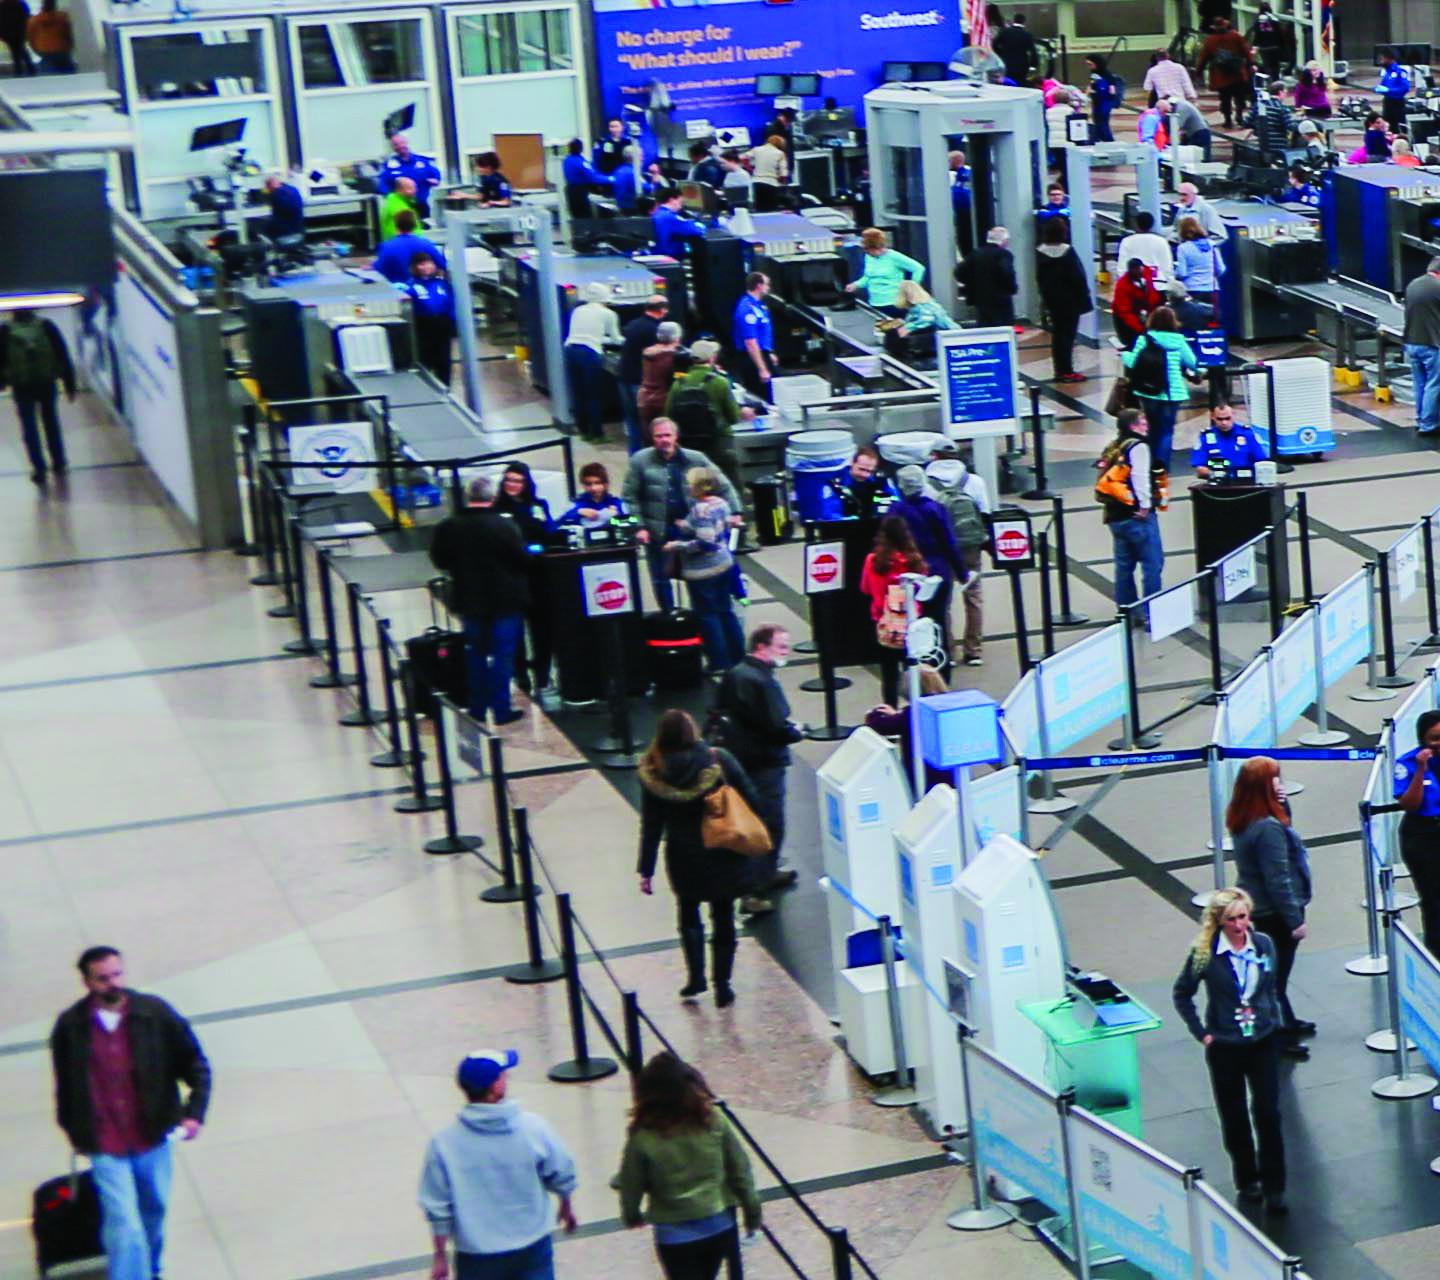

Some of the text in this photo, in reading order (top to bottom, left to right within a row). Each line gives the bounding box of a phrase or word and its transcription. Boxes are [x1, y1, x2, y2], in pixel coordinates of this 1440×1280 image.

[860, 9, 939, 31] Southwest
[616, 24, 732, 48] No charge for
[677, 46, 735, 66] should
[996, 537, 1029, 551] STOP
[810, 562, 838, 575] STOP
[594, 588, 628, 605] STOP
[1100, 751, 1175, 767] clearme.com
